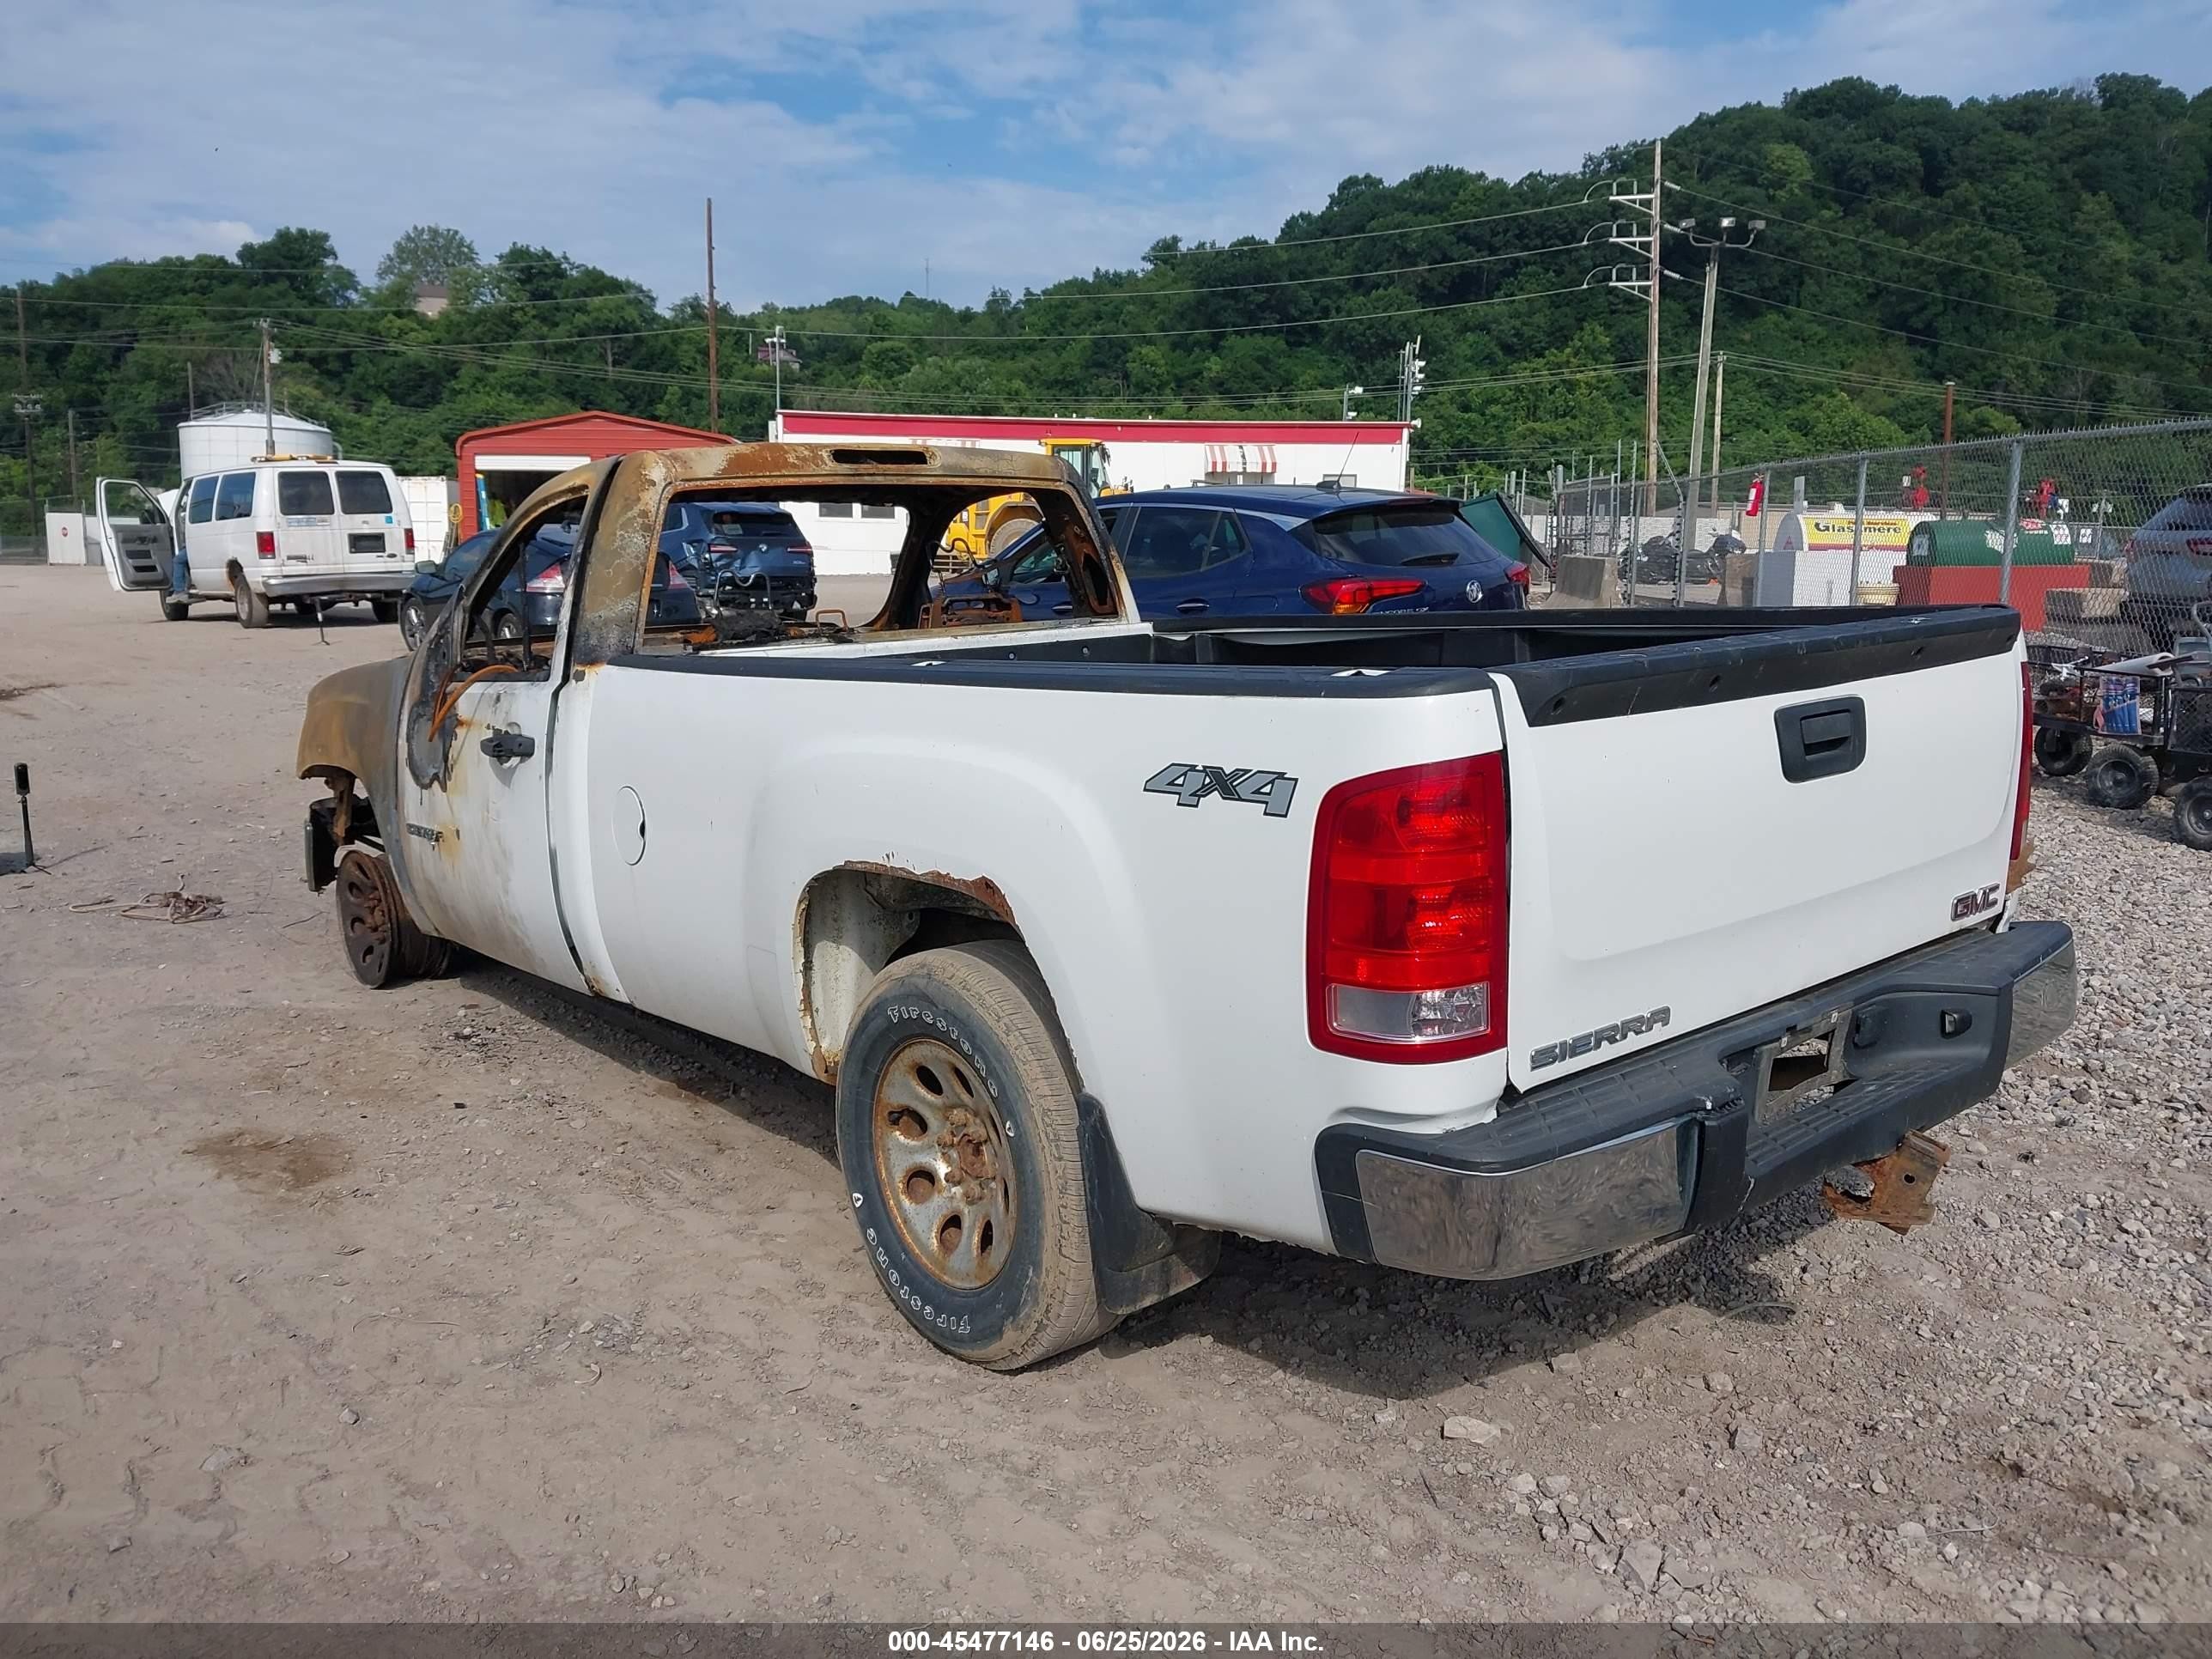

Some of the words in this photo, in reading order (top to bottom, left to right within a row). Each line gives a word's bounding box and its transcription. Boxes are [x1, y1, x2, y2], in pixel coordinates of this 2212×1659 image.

[1814, 521, 1901, 534] Glasmere
[1951, 882, 2001, 921] GMC
[887, 1005, 999, 1098] Firestone
[1530, 1006, 1671, 1072] SIERRA
[866, 1228, 971, 1334] Firestone
